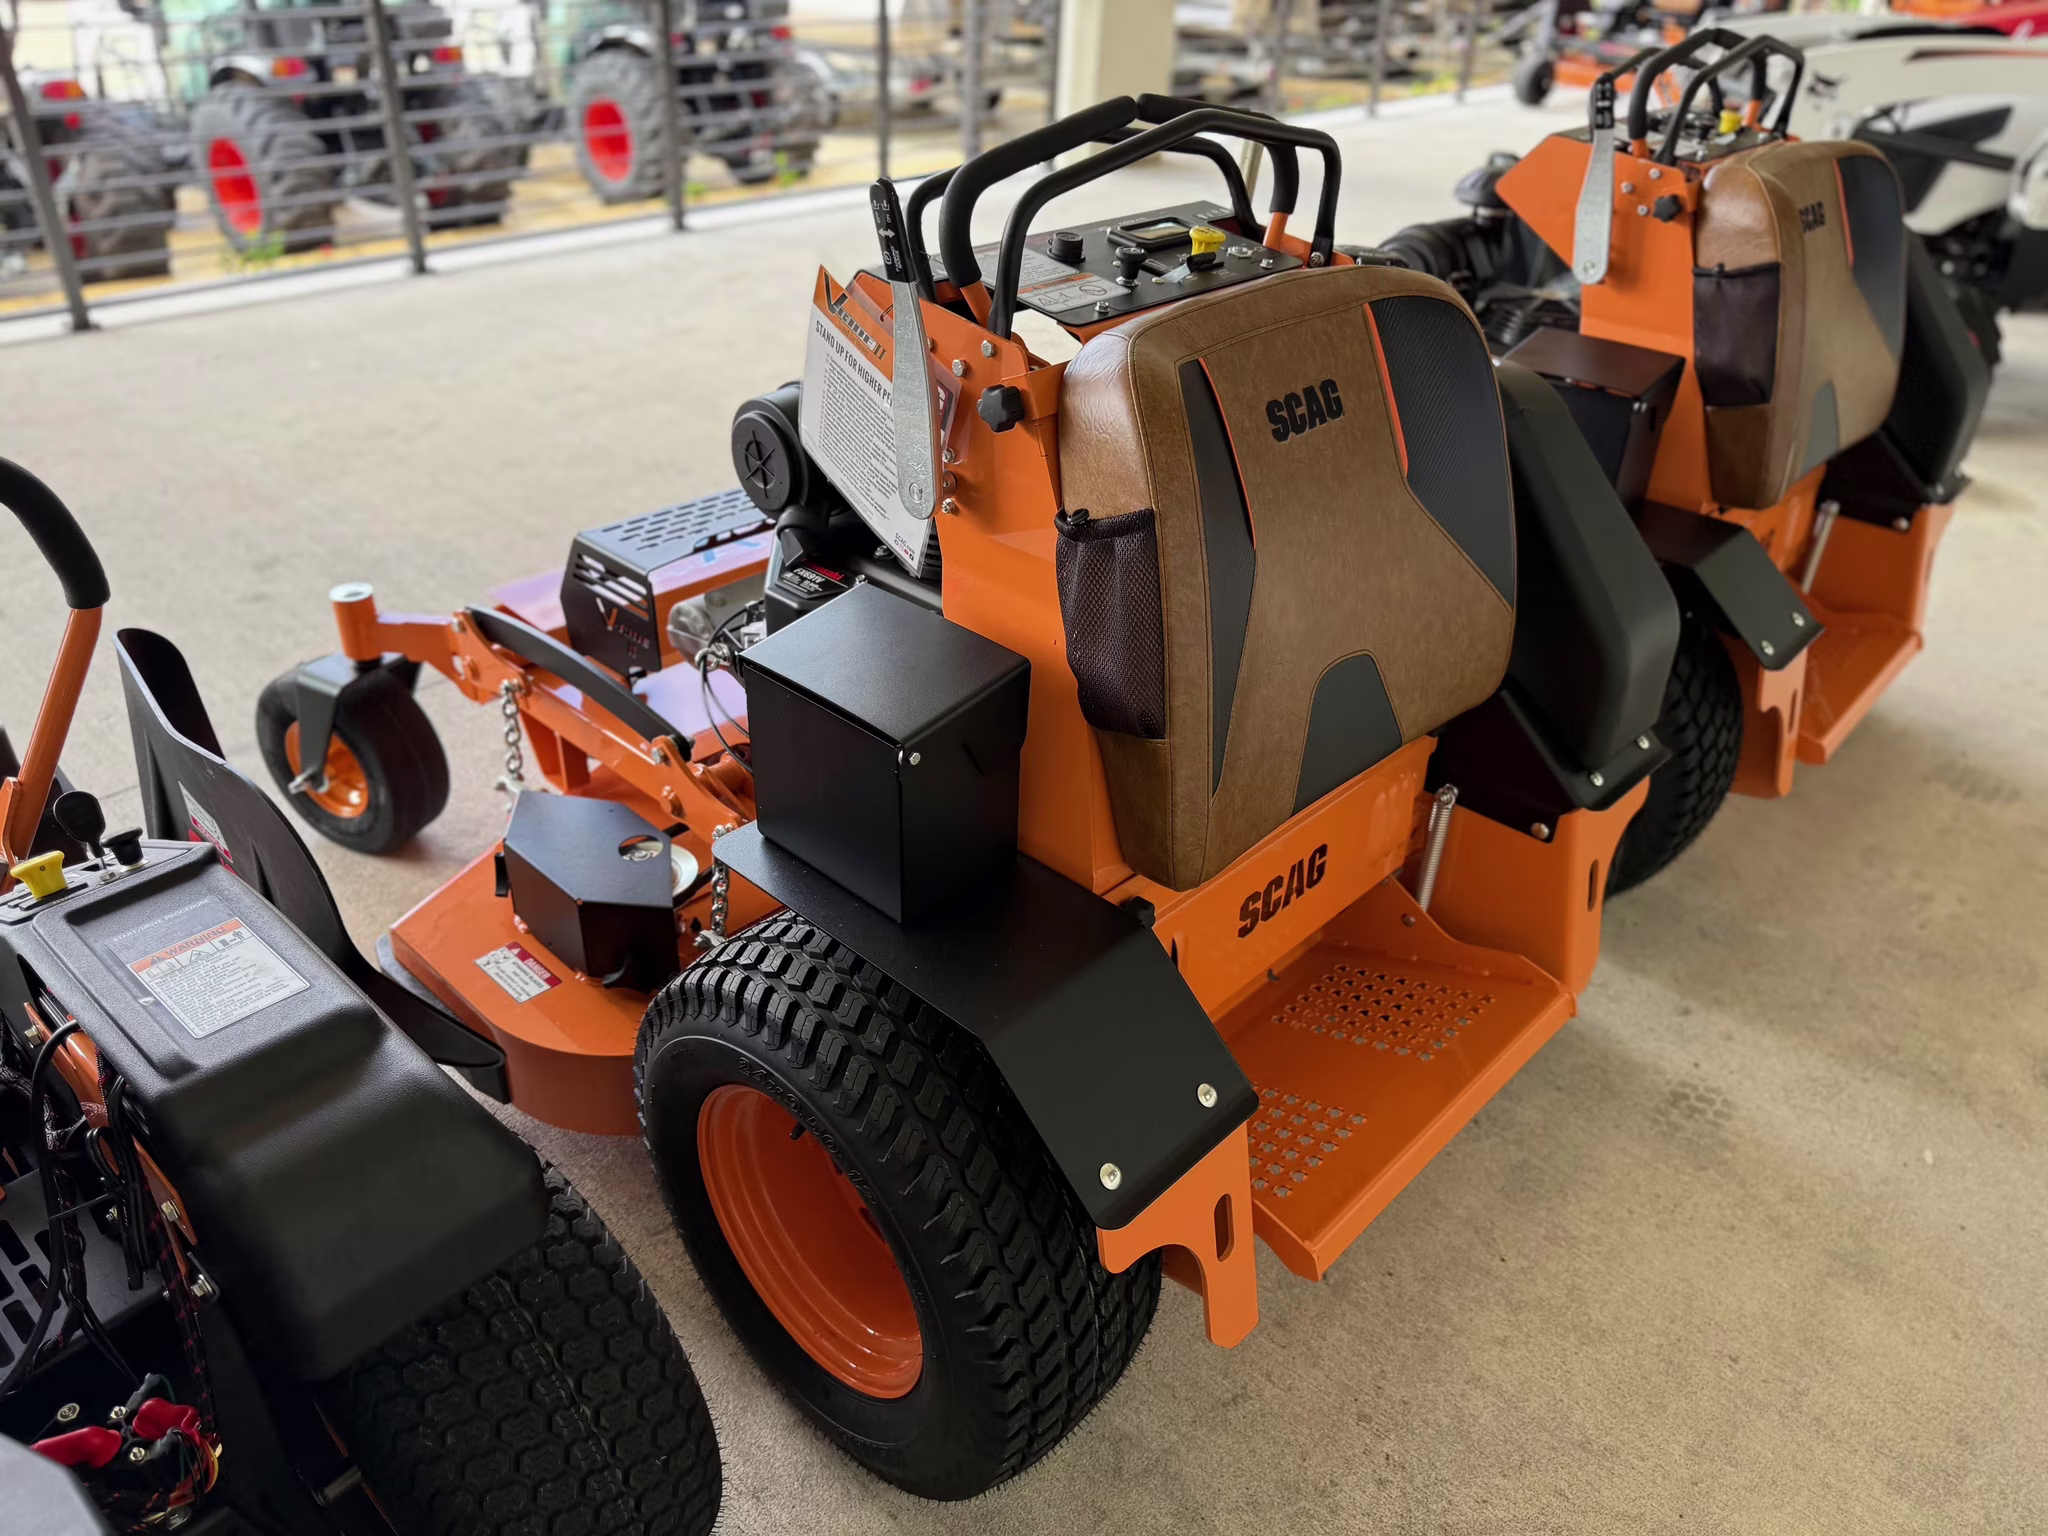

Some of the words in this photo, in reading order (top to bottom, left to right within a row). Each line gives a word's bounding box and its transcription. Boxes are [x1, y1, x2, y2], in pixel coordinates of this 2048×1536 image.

[1799, 201, 1825, 232] SCAG
[815, 319, 835, 348] STAND
[835, 338, 845, 358] UP
[844, 349, 858, 372] FOR
[857, 363, 883, 397] HIGHER
[1265, 378, 1343, 443] SCAG
[793, 567, 825, 584] FX691V
[1237, 843, 1328, 939] SCAG
[164, 898, 210, 921] PROCEDURE
[164, 926, 228, 956] WARNING
[523, 957, 552, 980] DANGER
